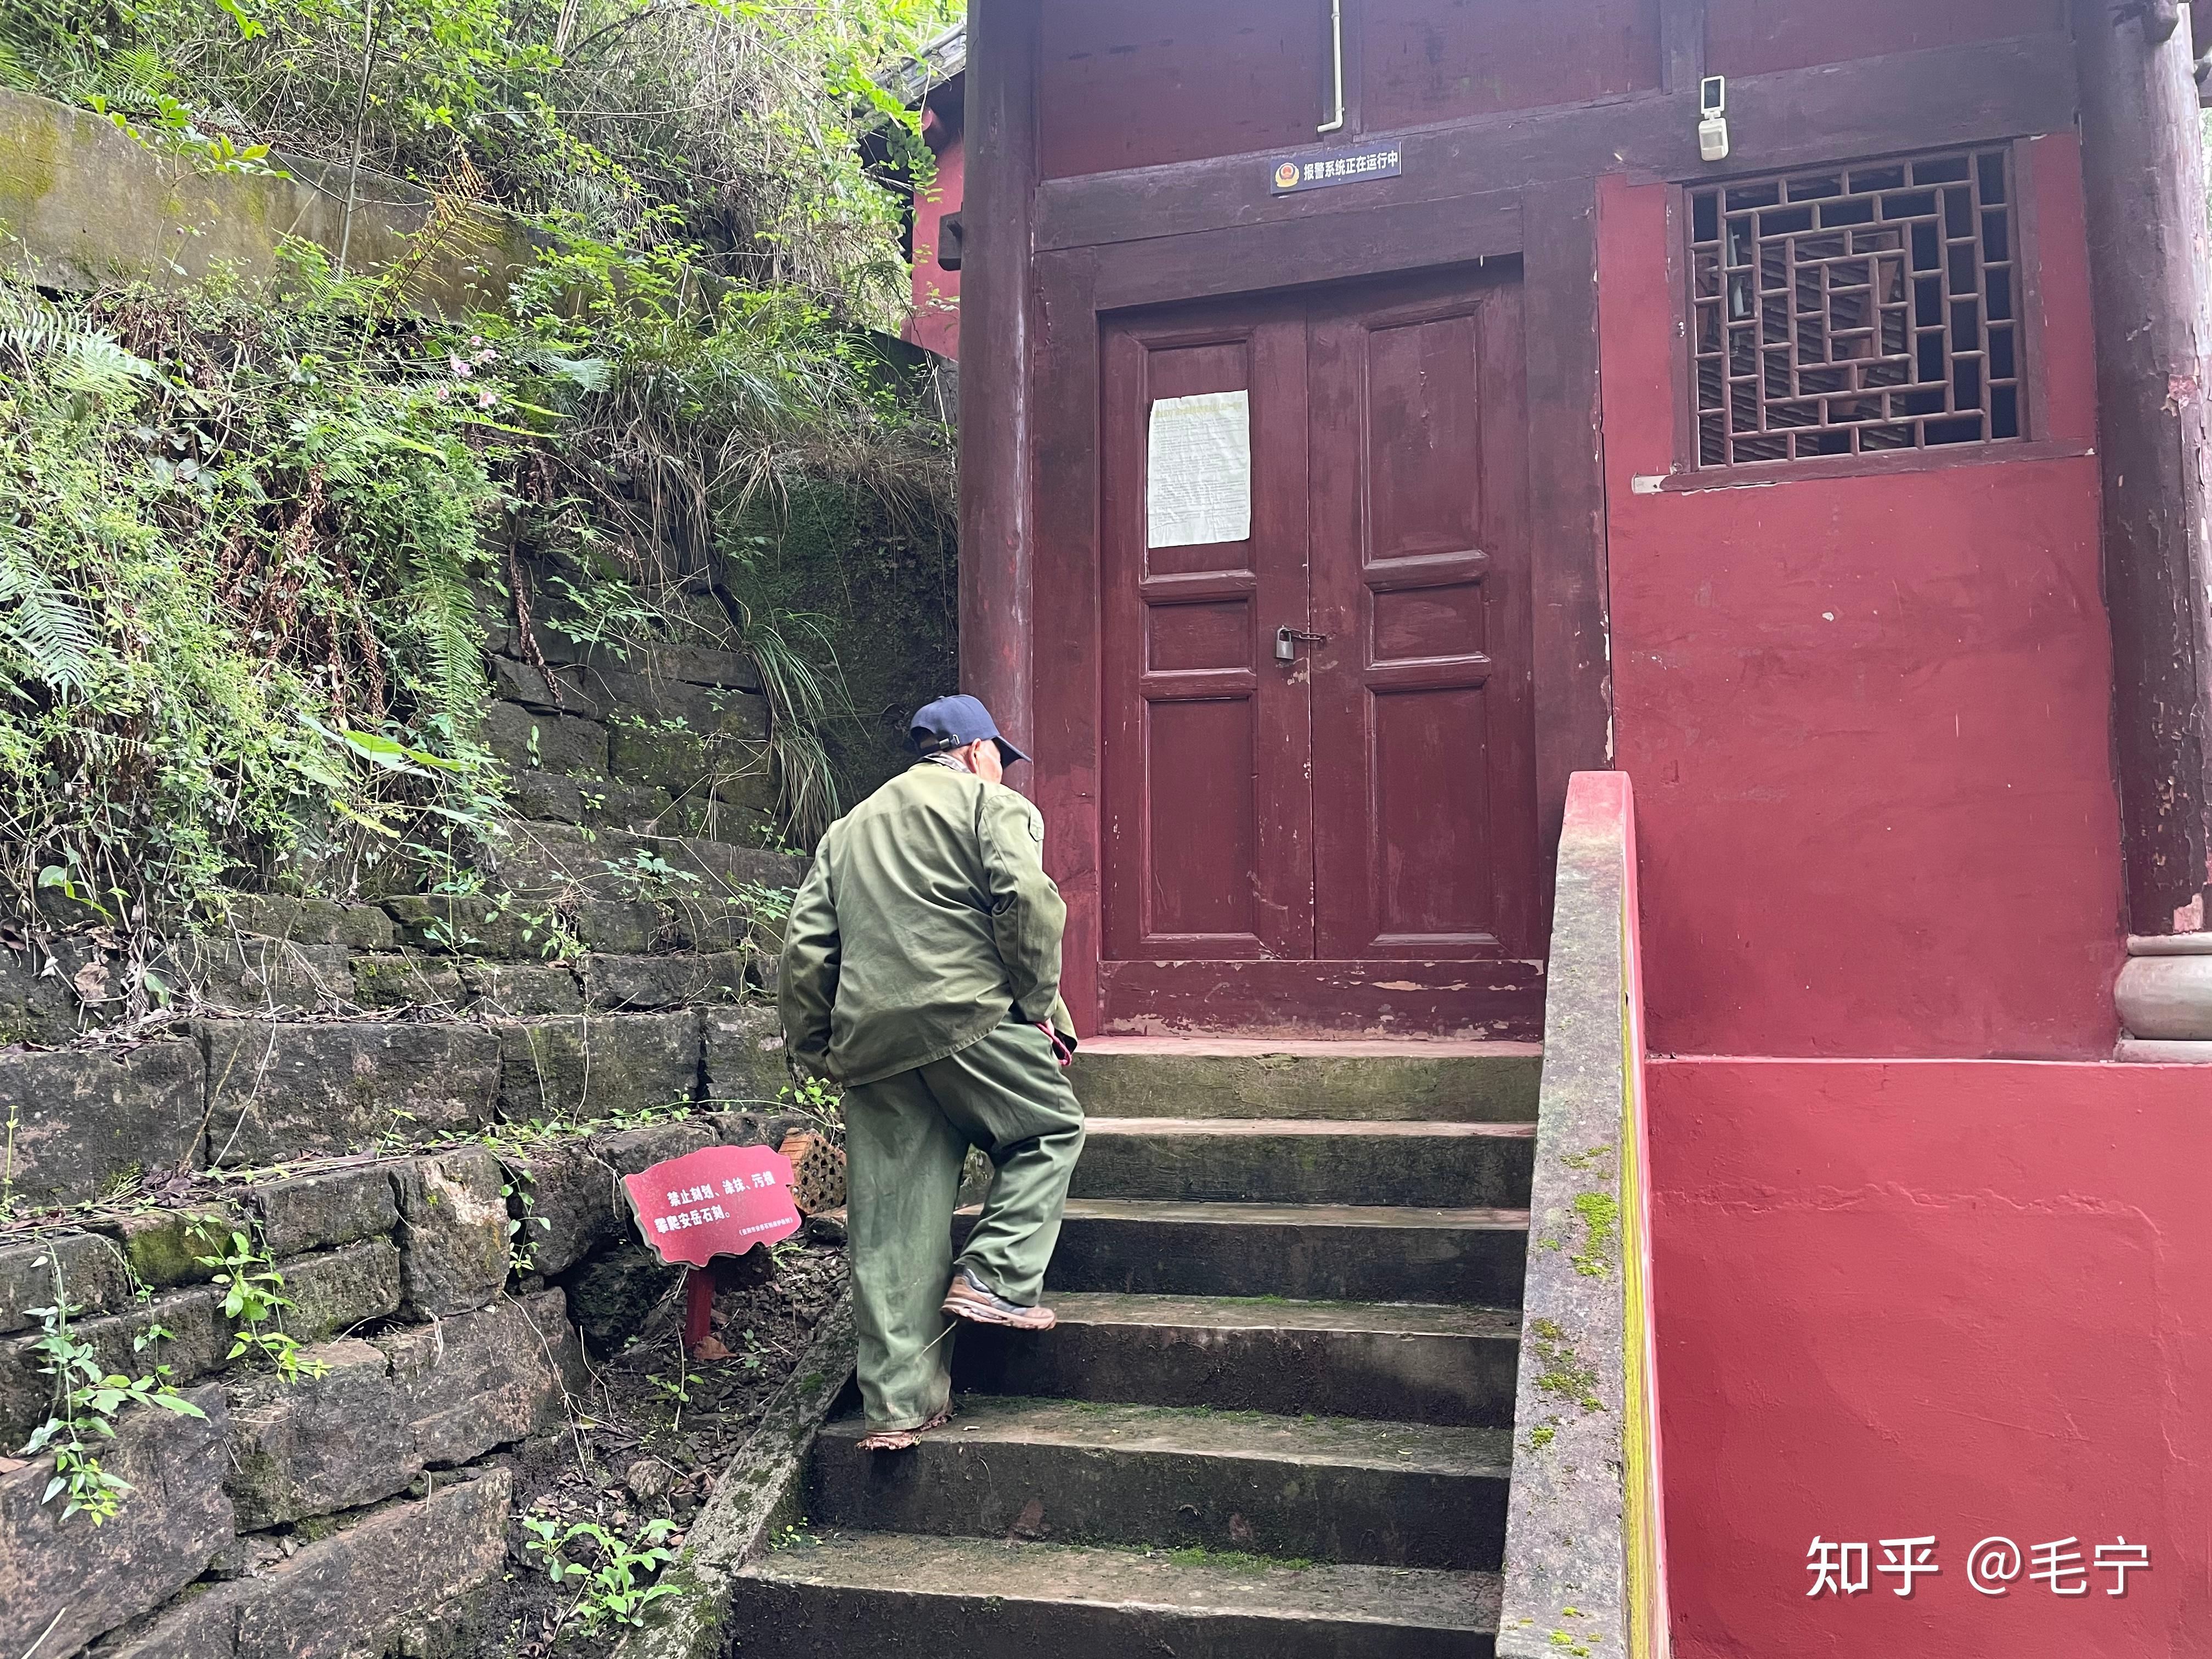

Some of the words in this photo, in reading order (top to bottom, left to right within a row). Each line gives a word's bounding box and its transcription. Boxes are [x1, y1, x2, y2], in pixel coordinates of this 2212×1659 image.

[1304, 150, 1398, 180] 报警系统正在运行中
